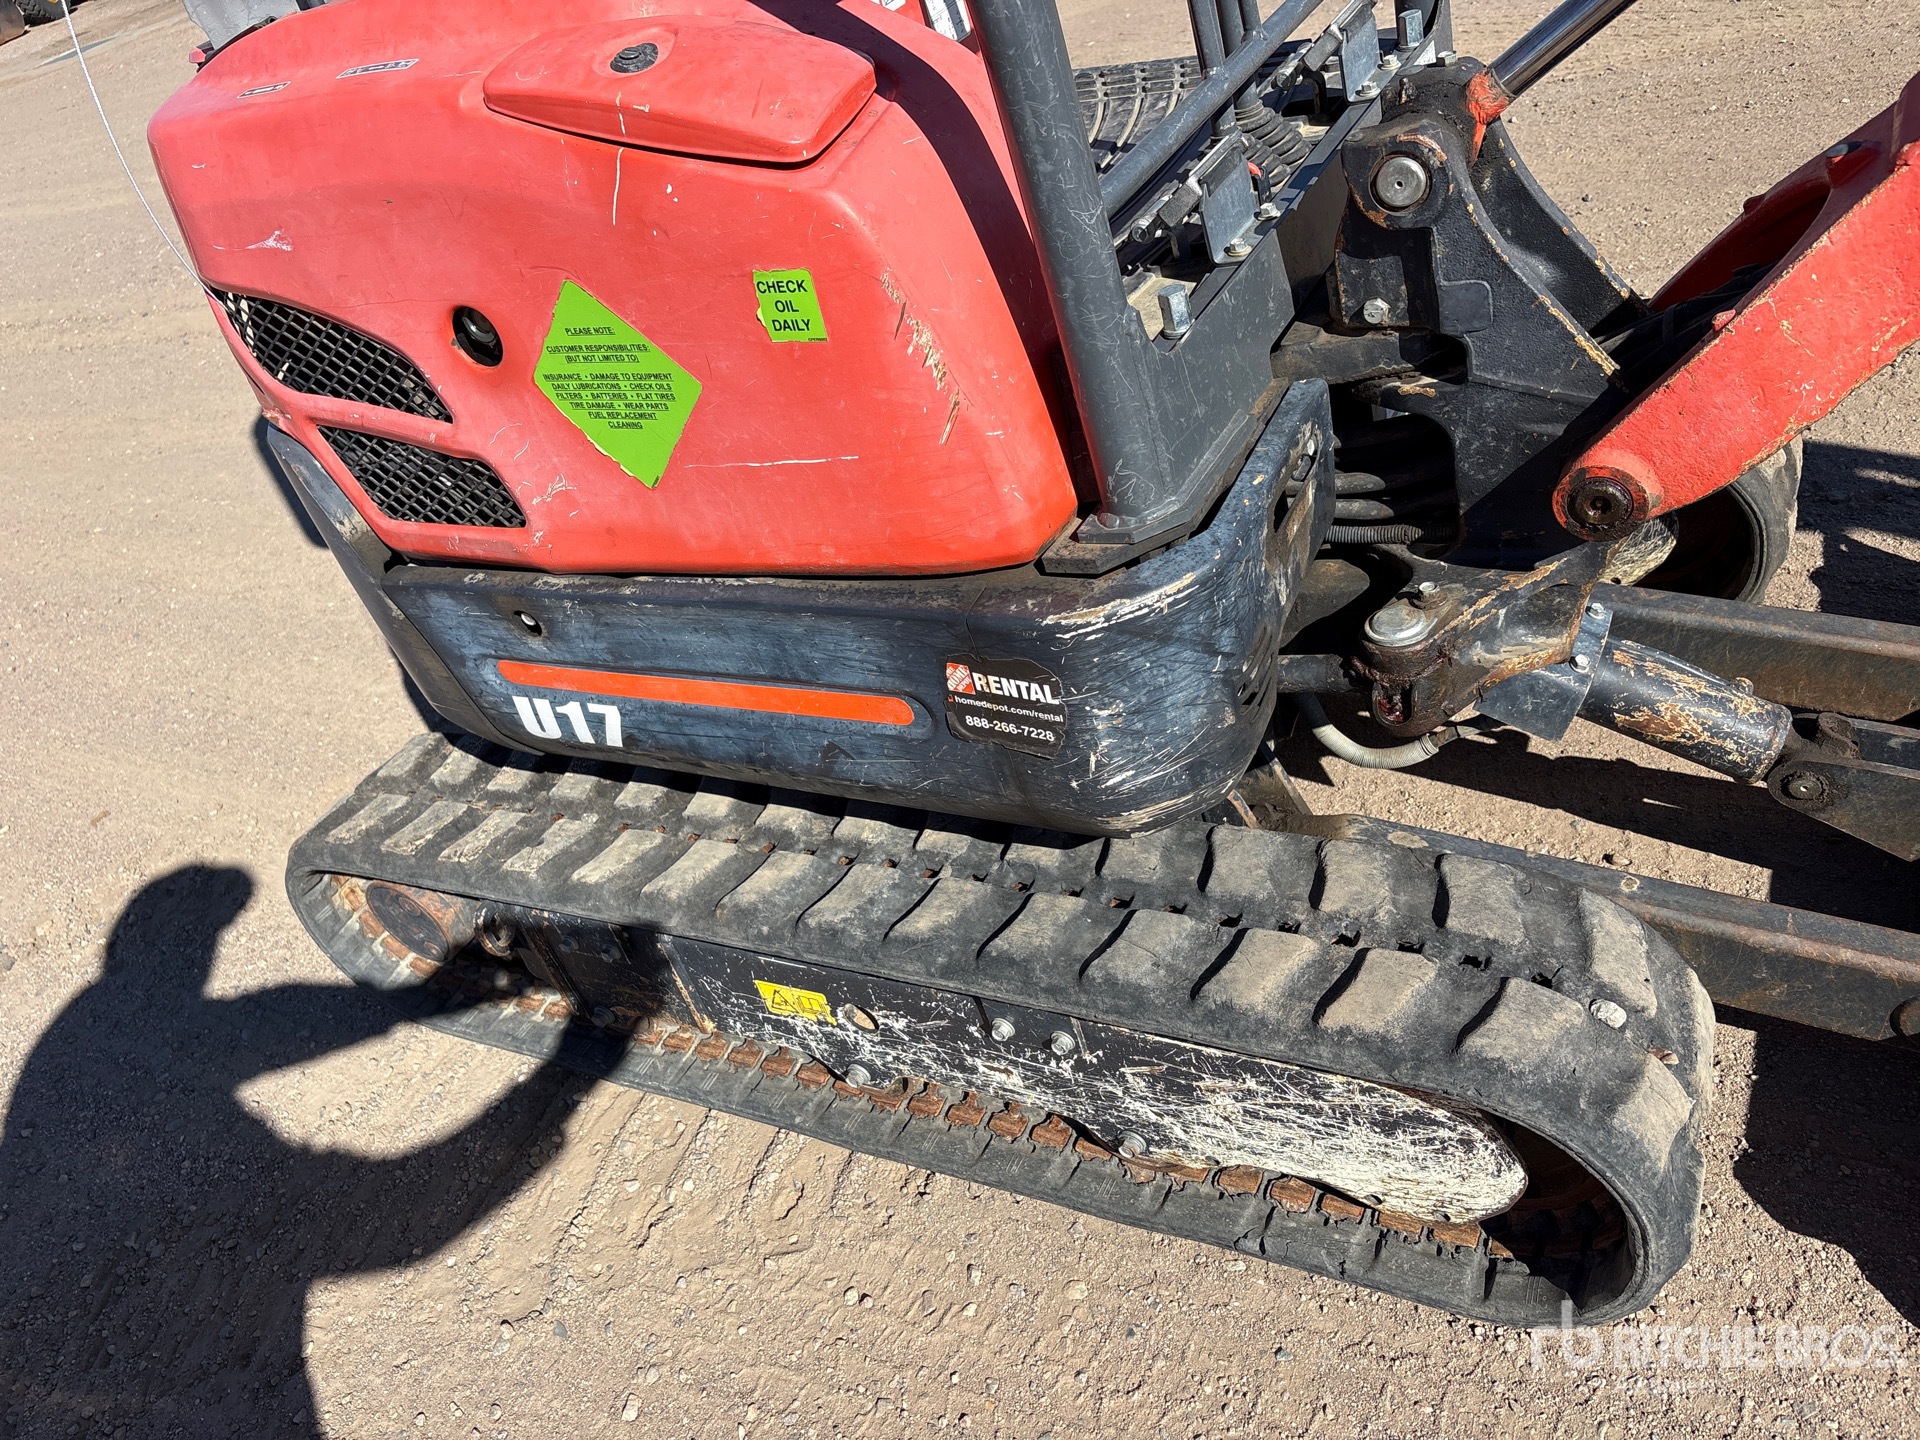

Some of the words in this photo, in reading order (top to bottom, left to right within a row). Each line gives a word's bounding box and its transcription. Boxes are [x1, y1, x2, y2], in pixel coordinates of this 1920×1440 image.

[756, 280, 808, 294] CHECK
[774, 300, 800, 313] OIL
[772, 319, 811, 332] DAILY
[565, 327, 592, 335] PLEASE
[594, 326, 616, 335] NOTE:
[546, 345, 585, 353] CUSTOMER
[585, 344, 650, 353] RESPONSIBILITIES:
[565, 354, 581, 363] (BUT
[582, 354, 598, 362] NOT
[599, 354, 626, 362] LIMITED
[626, 354, 640, 363] TO)
[543, 373, 583, 381] INSURANCE
[631, 373, 673, 381] EQUIPMENT
[655, 383, 672, 391] OILS
[556, 392, 583, 400] FILTERS
[590, 392, 629, 400] BATTERIES
[636, 392, 653, 400] FLAT
[654, 393, 676, 401] TIRES
[623, 402, 645, 410] WEAR
[645, 402, 669, 410] PARTS
[588, 411, 607, 419] FUEL
[606, 411, 657, 420] REPLACEMENT
[608, 421, 643, 429] CLEANING
[972, 672, 1060, 705] RENTAL
[955, 695, 1064, 722] homedepot.com/rental
[511, 695, 623, 748] U17
[965, 715, 1056, 742] 888-266-7228
